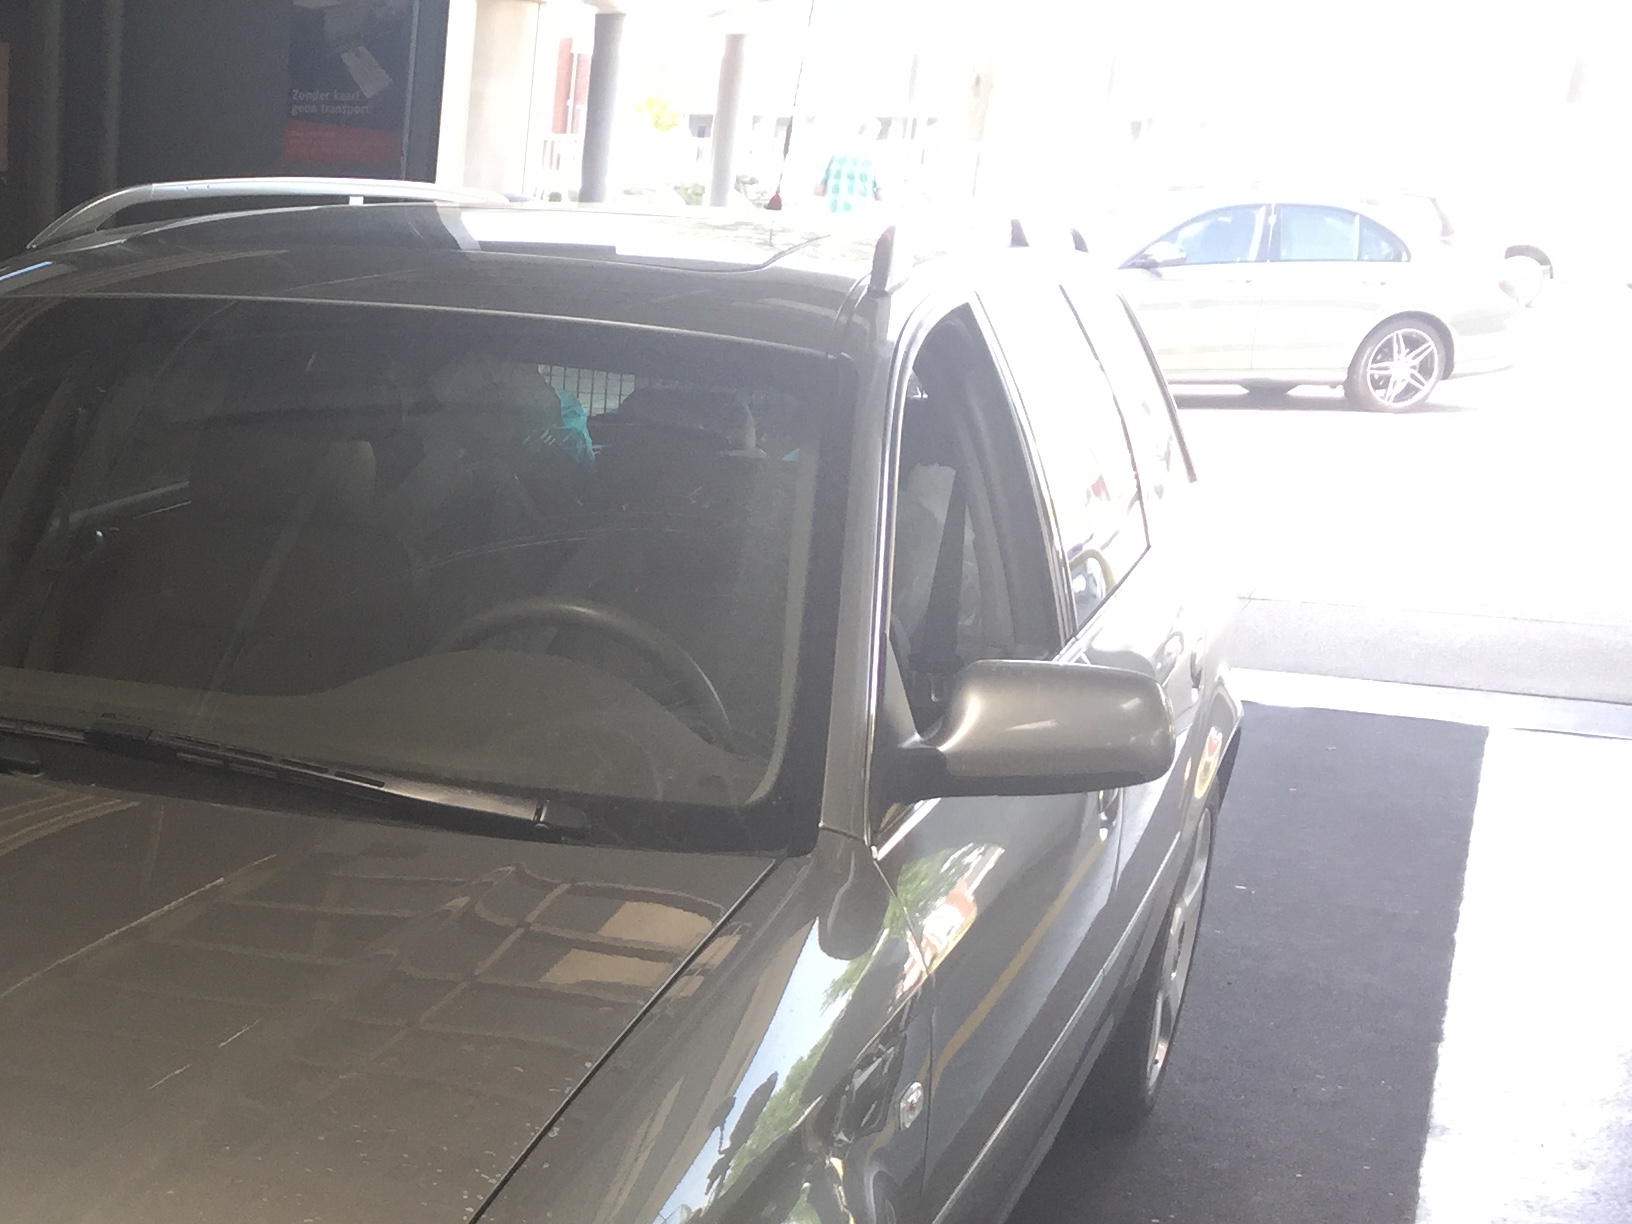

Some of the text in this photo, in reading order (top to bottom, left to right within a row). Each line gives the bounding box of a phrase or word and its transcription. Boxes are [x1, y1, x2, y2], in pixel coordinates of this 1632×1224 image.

[292, 89, 360, 101] Zonder kaart
[291, 103, 369, 117] geen transport
